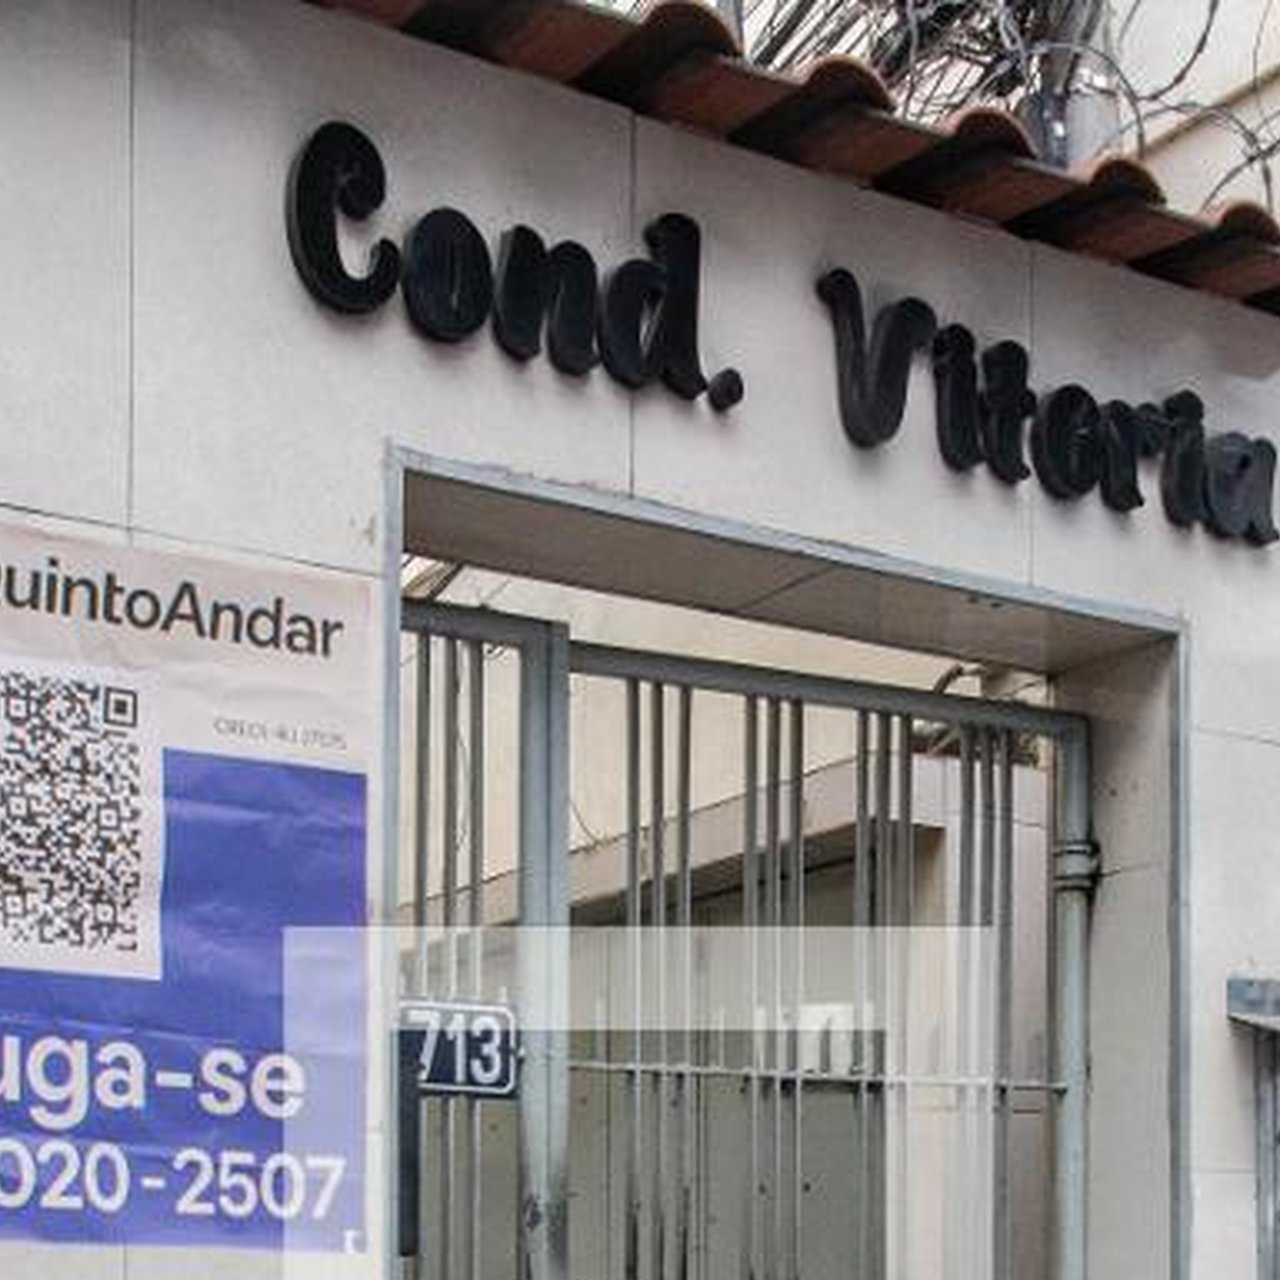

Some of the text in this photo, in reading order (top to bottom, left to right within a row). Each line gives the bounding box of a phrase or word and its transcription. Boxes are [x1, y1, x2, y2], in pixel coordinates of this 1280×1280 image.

[286, 121, 1280, 546] Cond. Vitoria
[406, 1009, 501, 1084] 713
